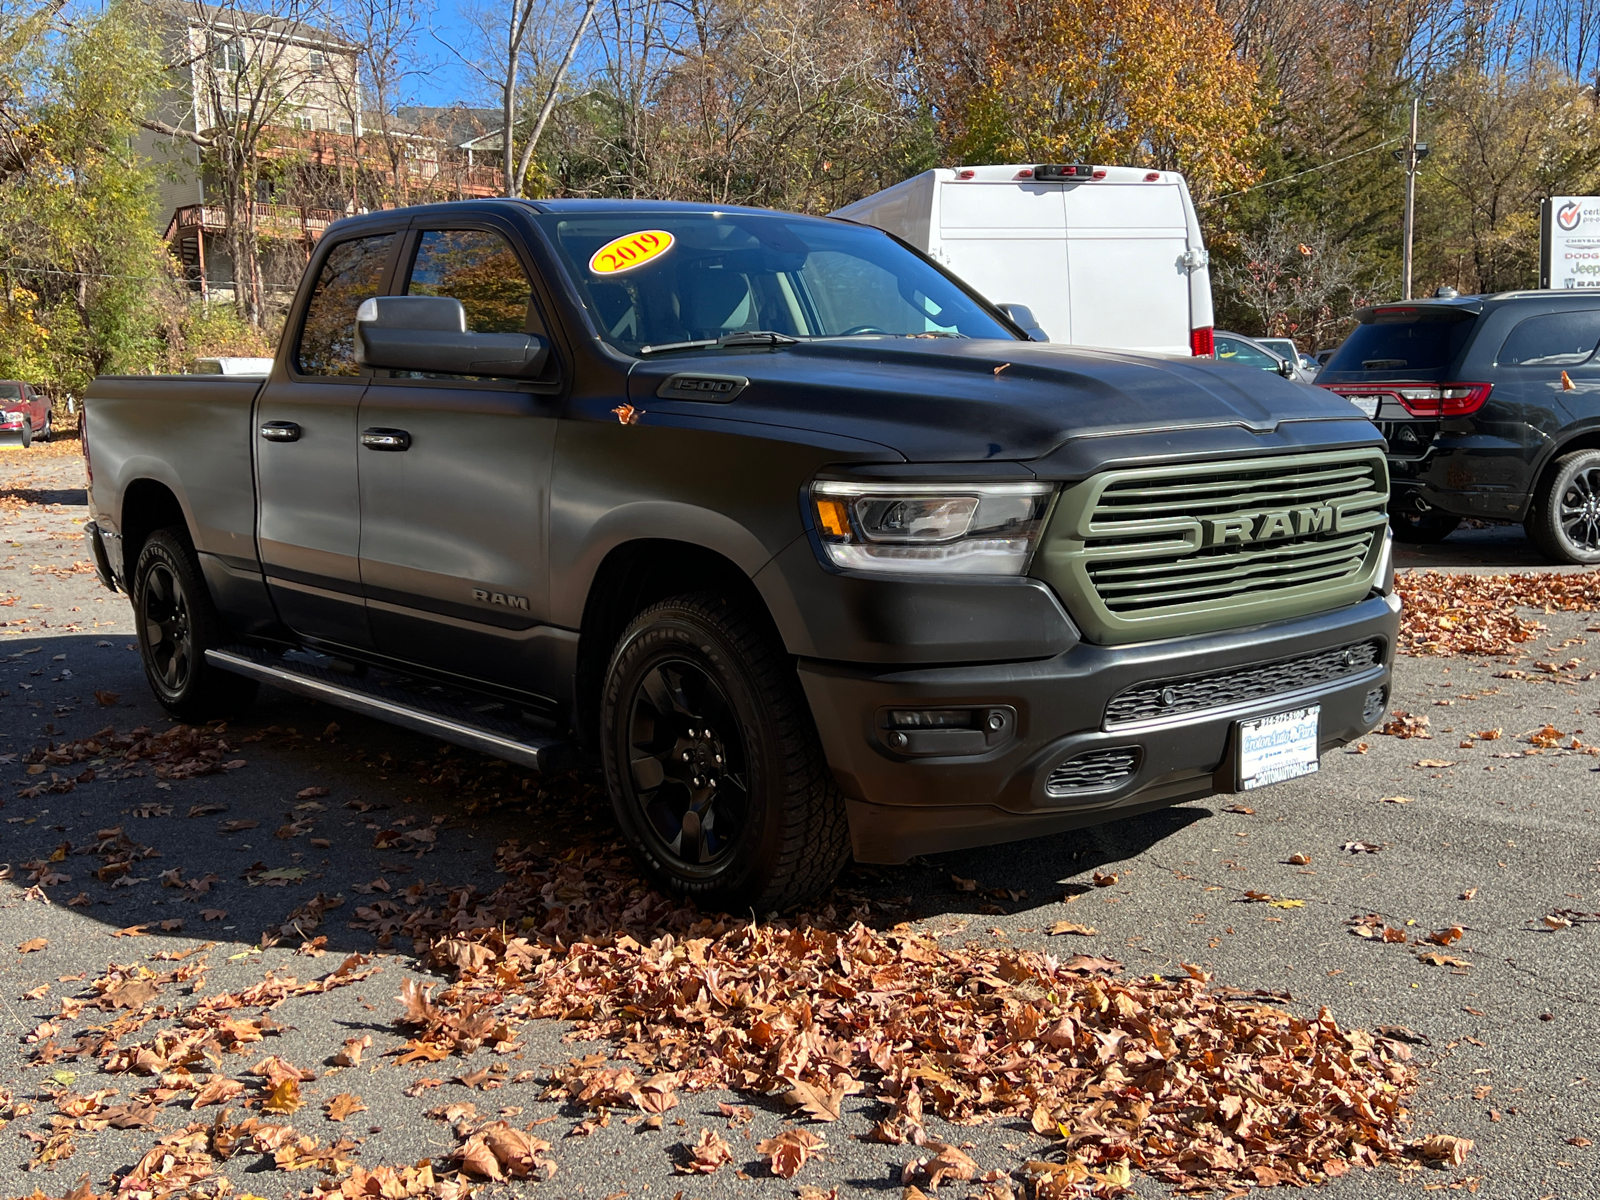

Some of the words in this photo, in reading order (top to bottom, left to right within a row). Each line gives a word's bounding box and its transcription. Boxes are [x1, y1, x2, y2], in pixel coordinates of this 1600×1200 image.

[1583, 208, 1600, 216] cert
[1583, 216, 1600, 224] pre-o
[601, 233, 660, 270] 2019
[1564, 252, 1600, 260] DODG
[1570, 261, 1600, 277] Jeep
[673, 379, 734, 393] 1500
[1210, 505, 1334, 545] RAM
[471, 587, 530, 611] RAM
